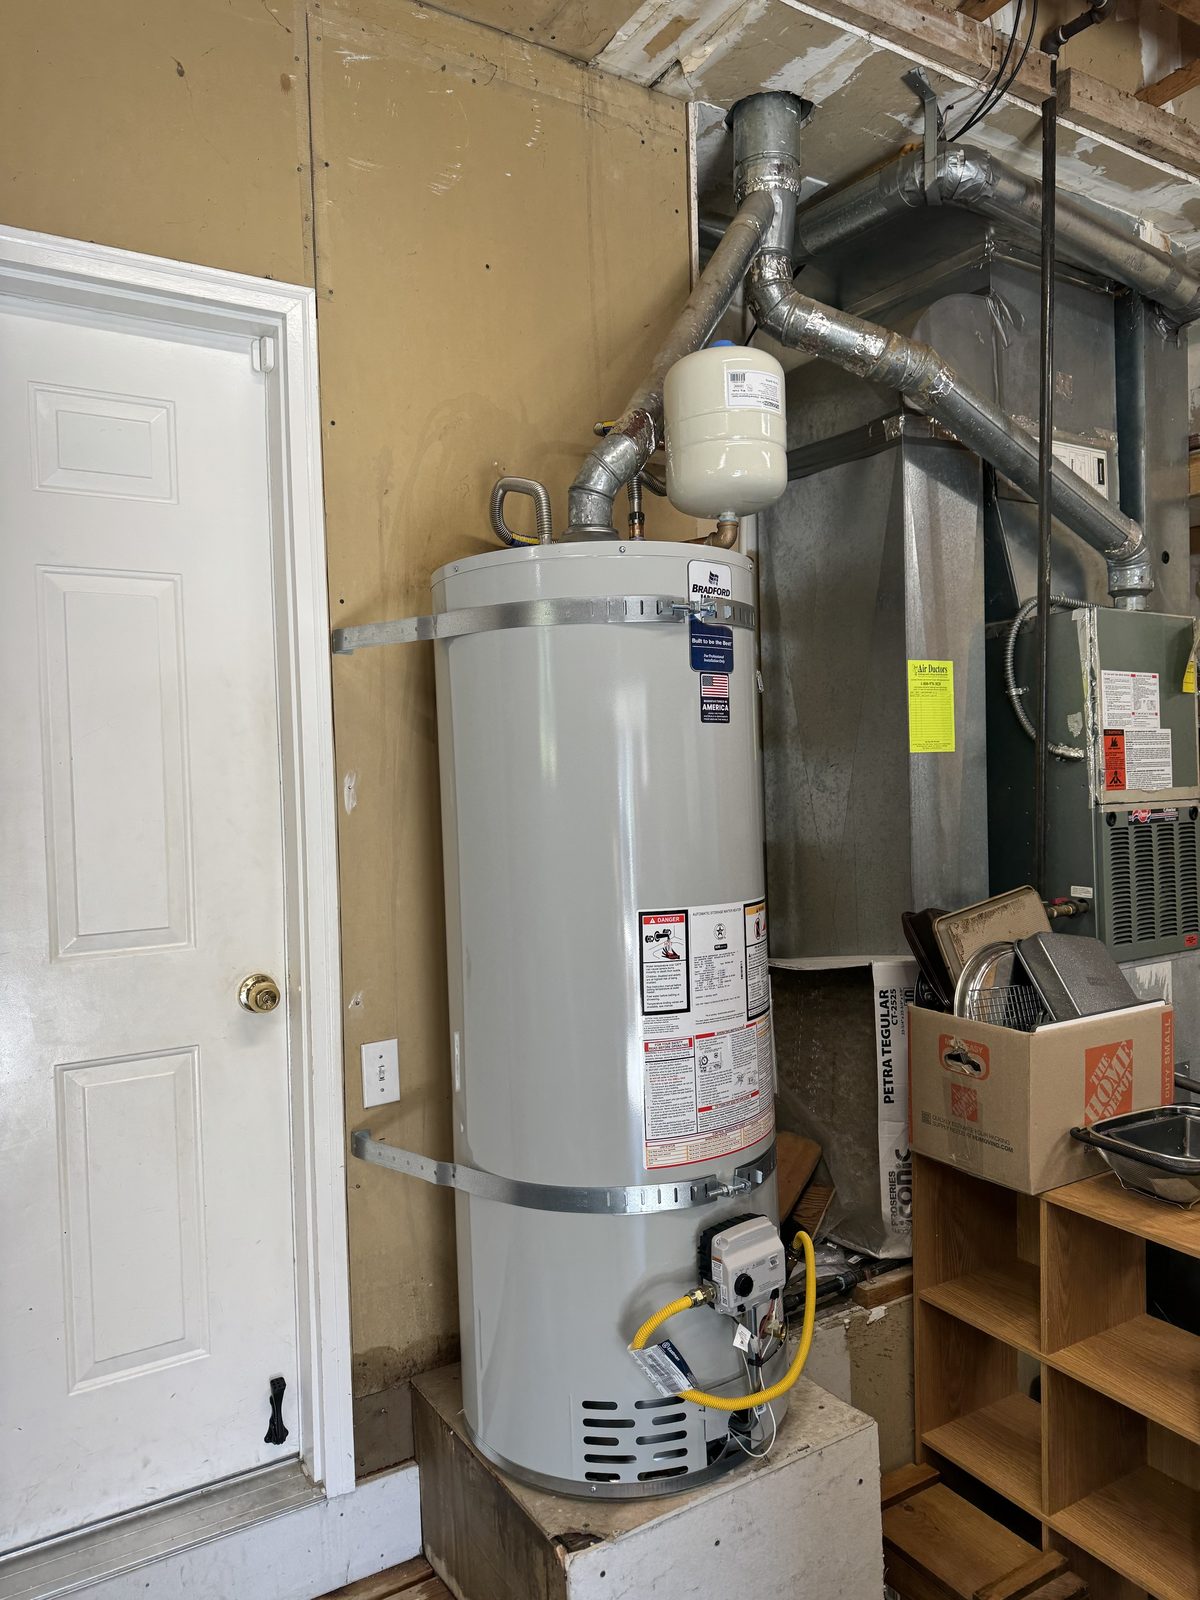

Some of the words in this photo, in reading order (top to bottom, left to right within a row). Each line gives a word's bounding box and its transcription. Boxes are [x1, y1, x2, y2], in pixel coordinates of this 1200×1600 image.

[691, 583, 731, 597] BRADFORD
[917, 663, 927, 673] Air
[878, 989, 892, 1057] TEGULAR
[890, 988, 899, 1026] CT-2525
[882, 1058, 895, 1104] PETRA
[1085, 1040, 1133, 1121] HOME
[1090, 1053, 1111, 1086] THE
[1103, 1068, 1133, 1118] DEPOT
